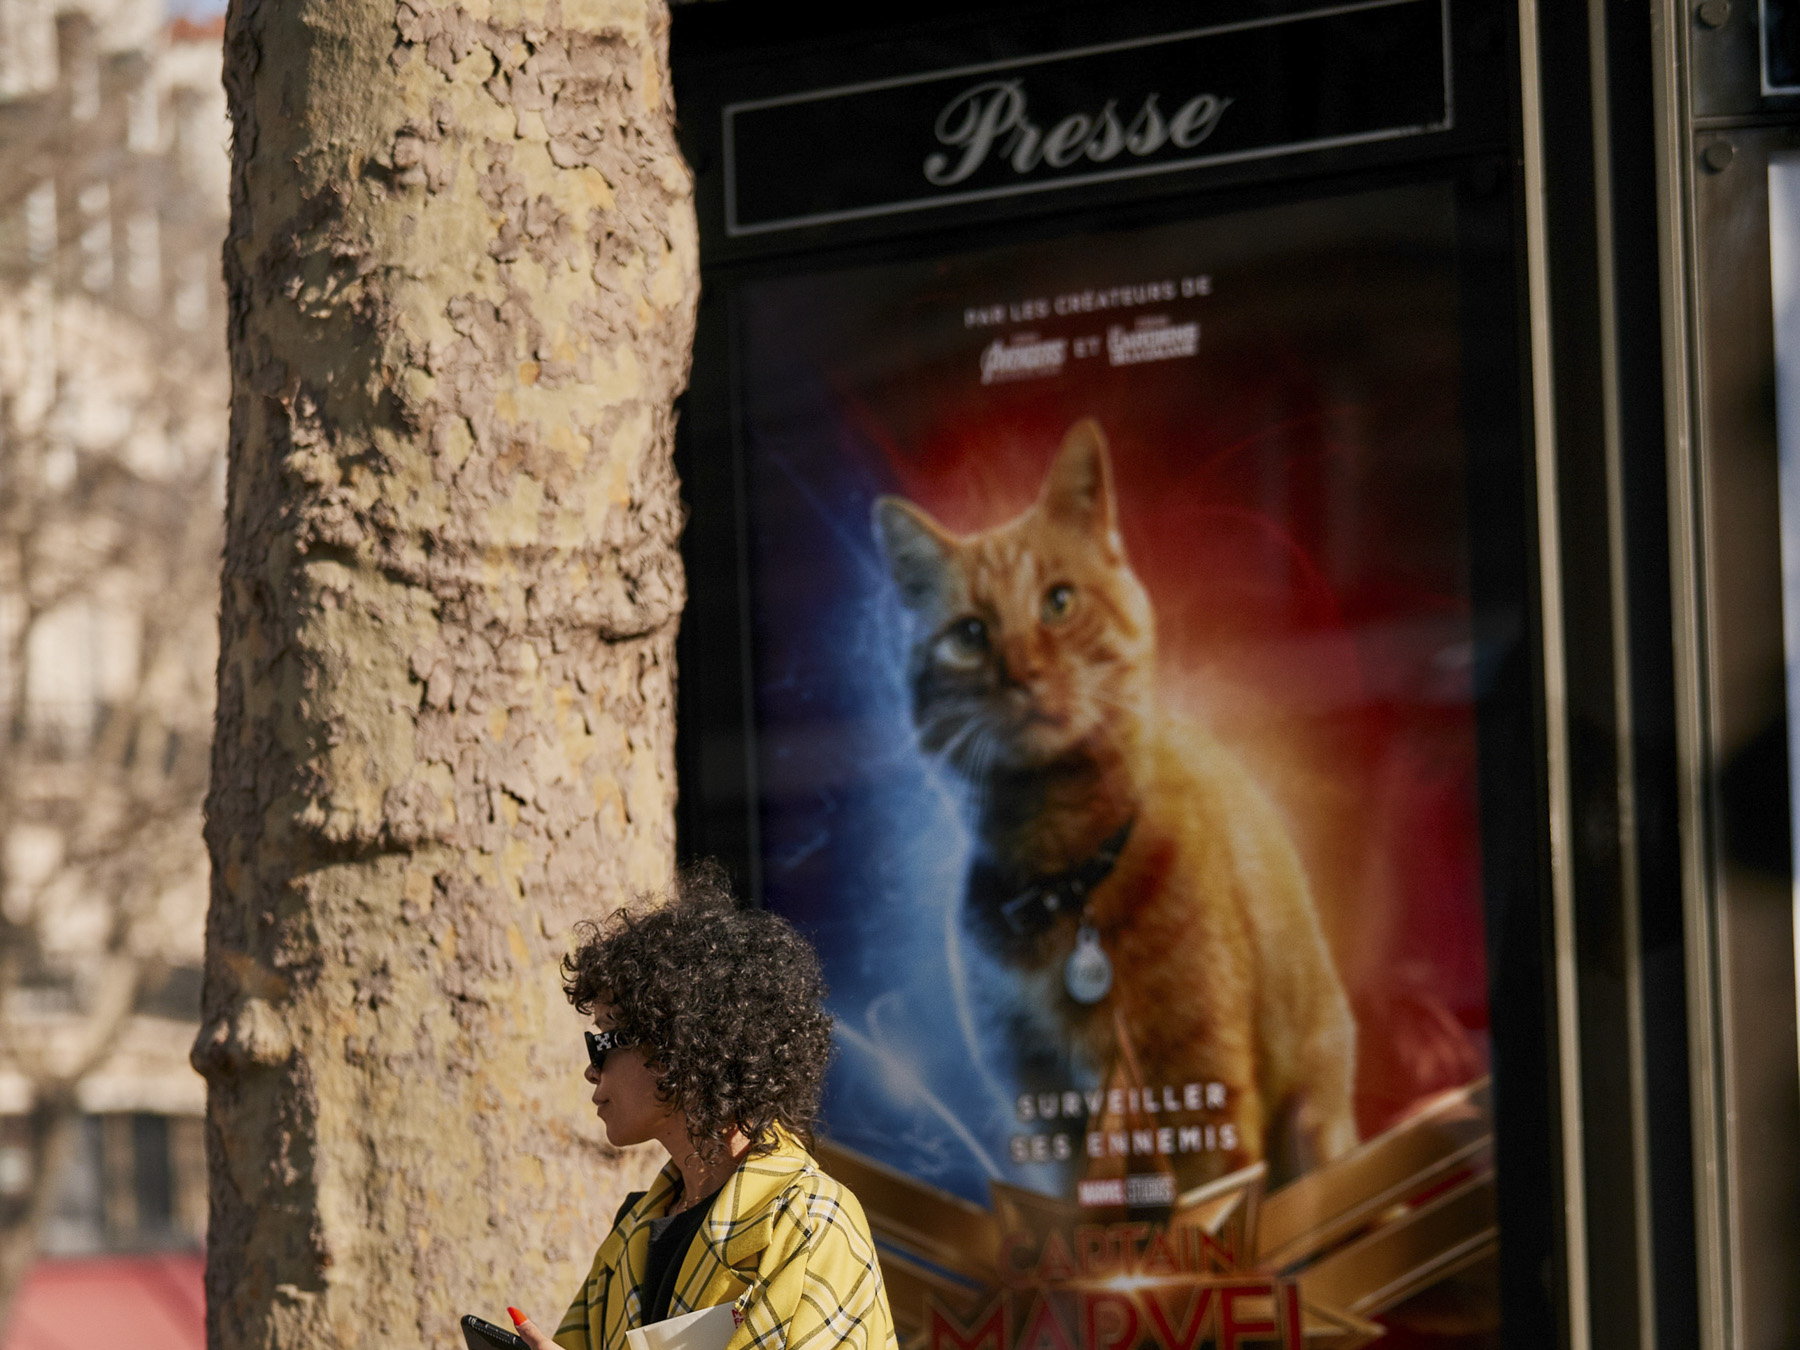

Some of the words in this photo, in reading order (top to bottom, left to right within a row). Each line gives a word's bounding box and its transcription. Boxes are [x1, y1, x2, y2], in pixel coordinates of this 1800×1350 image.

[923, 78, 1234, 186] Presse
[963, 303, 1007, 329] PAR
[1009, 297, 1051, 322] LES
[1053, 281, 1178, 316] CRÉATEURS
[1180, 275, 1213, 299] DE
[1017, 1081, 1227, 1122] SURVEILLER
[1010, 1133, 1072, 1163] SES
[1086, 1123, 1238, 1158] ENNEMIS
[1000, 1222, 1238, 1289] CAPTAIN
